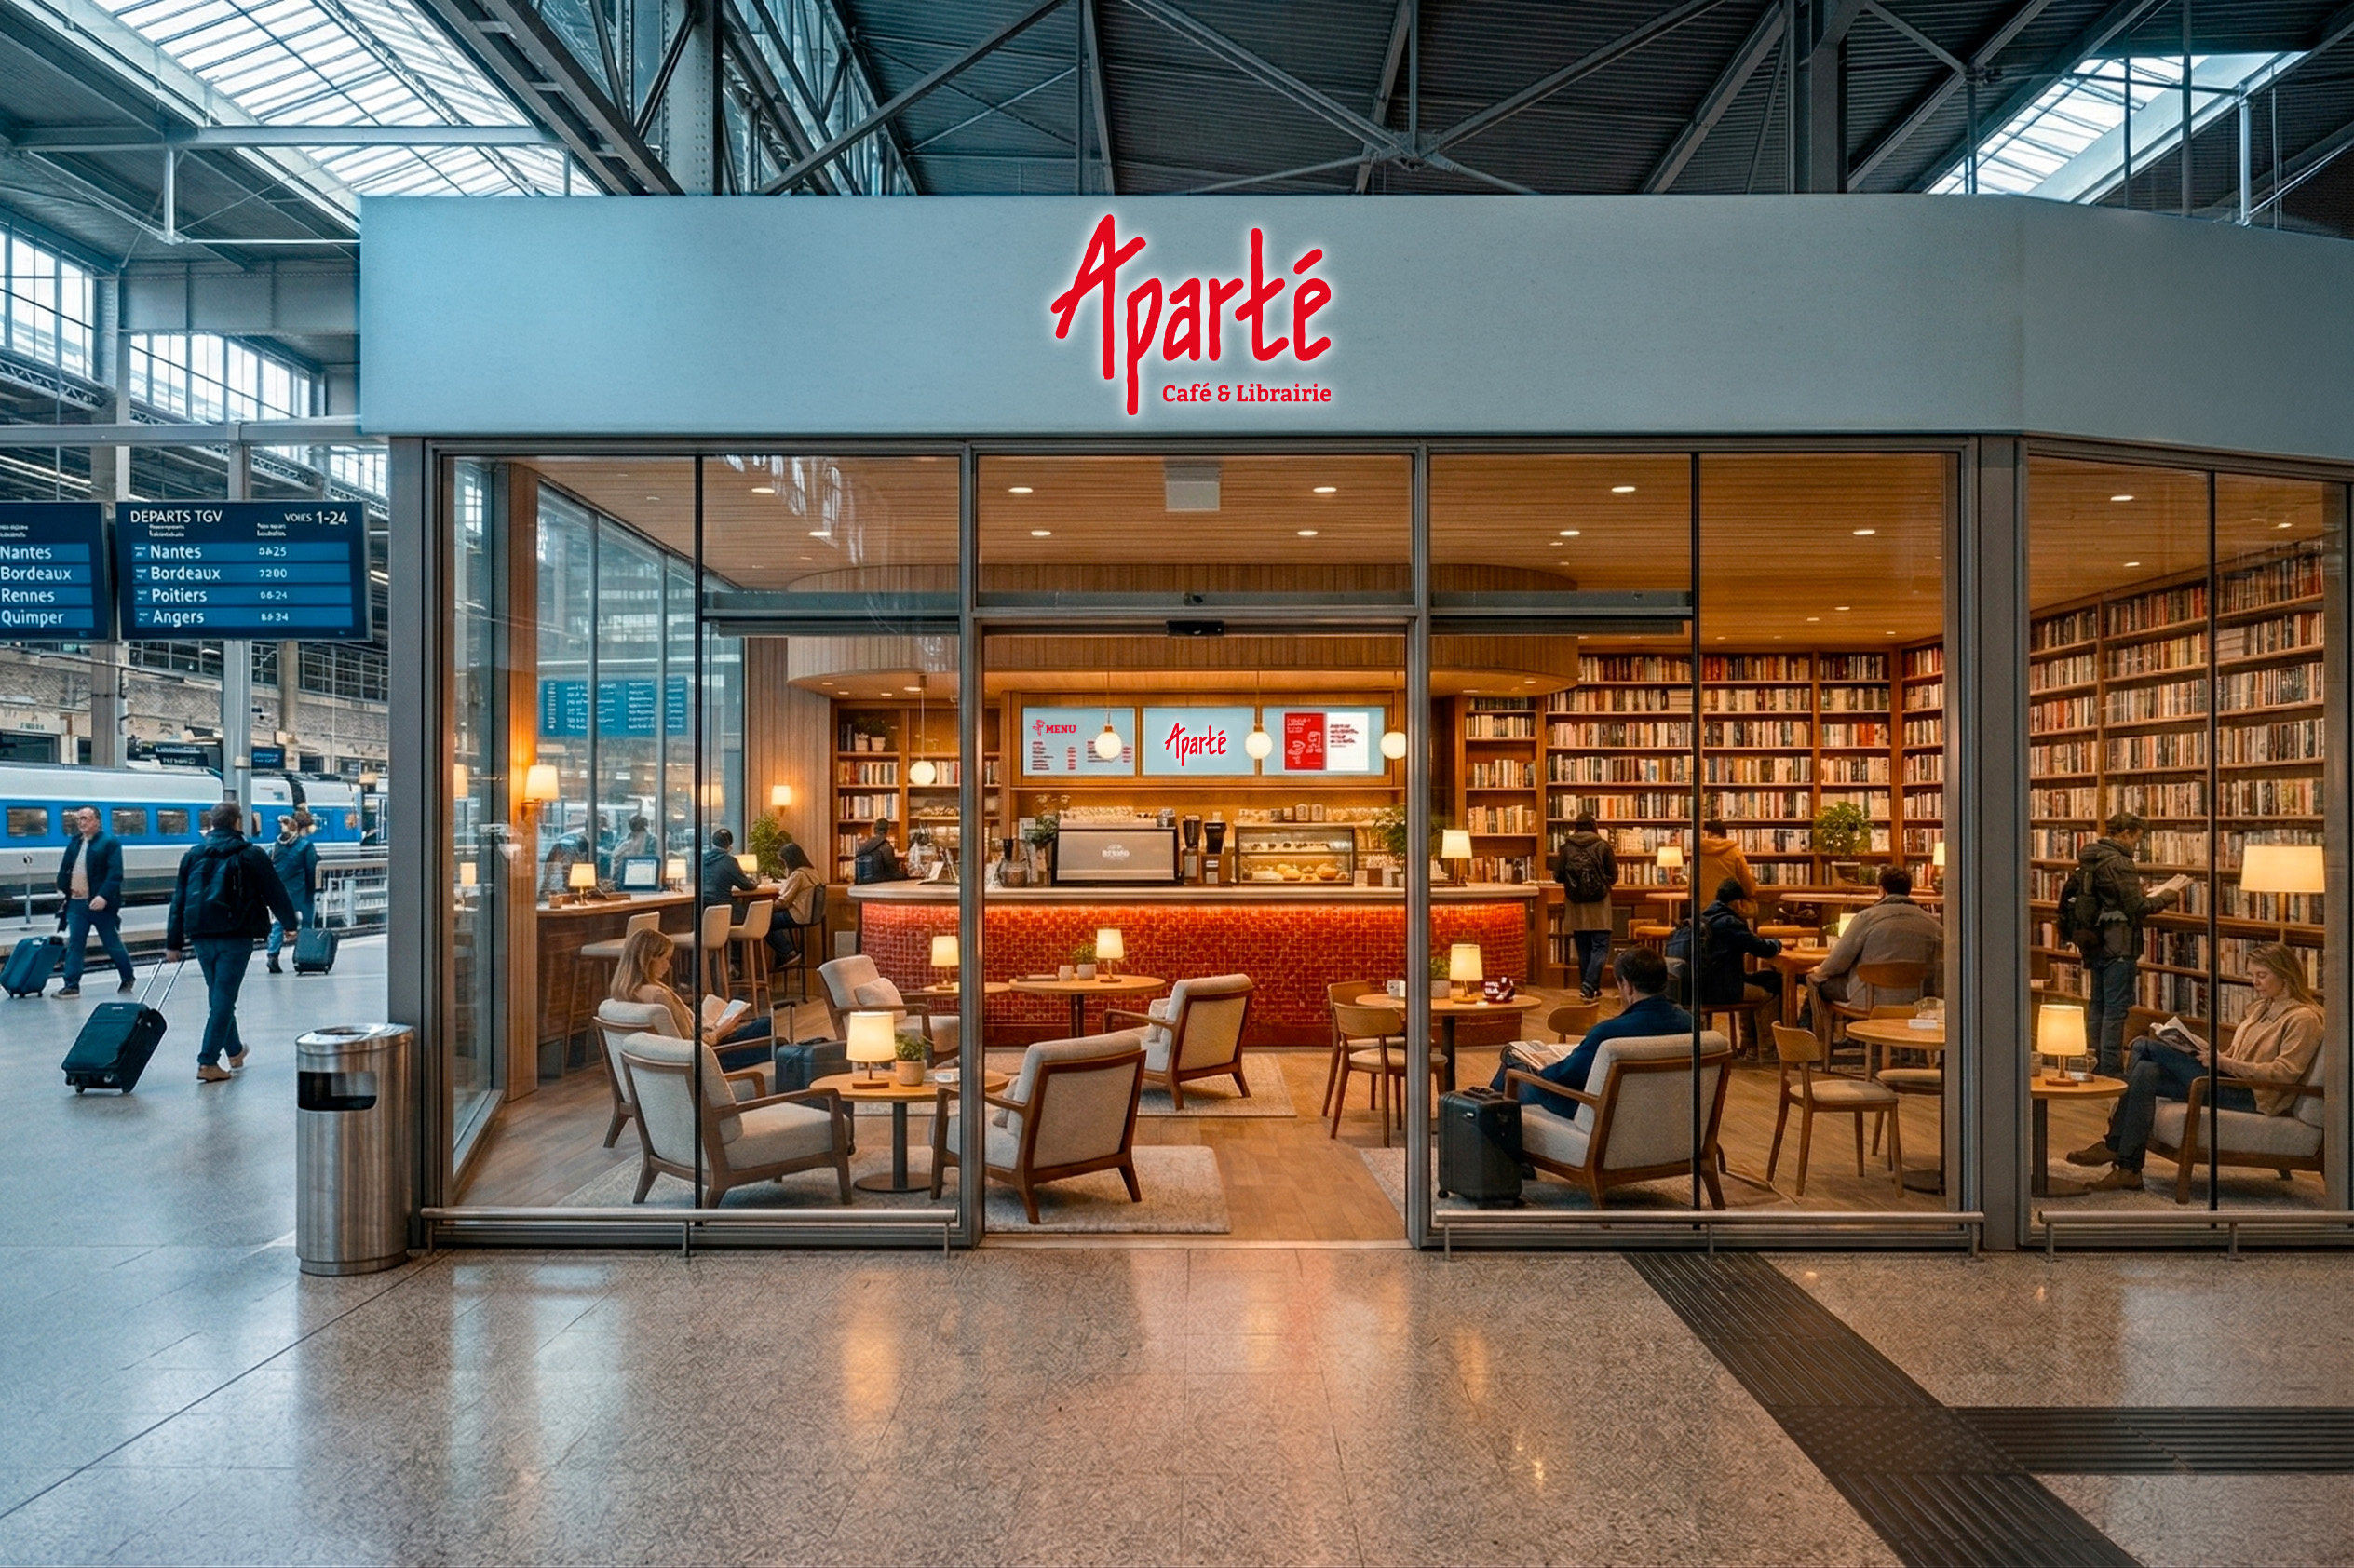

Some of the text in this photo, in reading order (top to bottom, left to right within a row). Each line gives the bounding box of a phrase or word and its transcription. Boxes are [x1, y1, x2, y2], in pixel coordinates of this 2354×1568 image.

[1050, 214, 1332, 415] Aparté
[1163, 382, 1332, 402] Café & Librairie
[194, 510, 223, 523] TGV
[316, 510, 349, 526] 1-24
[0, 546, 52, 560] Nantes
[150, 545, 202, 560] Nantes
[0, 566, 72, 581] Bordeaux
[151, 566, 222, 581] Bordeaux
[1, 588, 56, 603] Rennes
[152, 588, 208, 603] Poitiers
[1, 608, 65, 629] Quimper
[153, 609, 205, 629] Angers
[1046, 725, 1076, 734] MENU
[1165, 723, 1226, 766] Aparté
